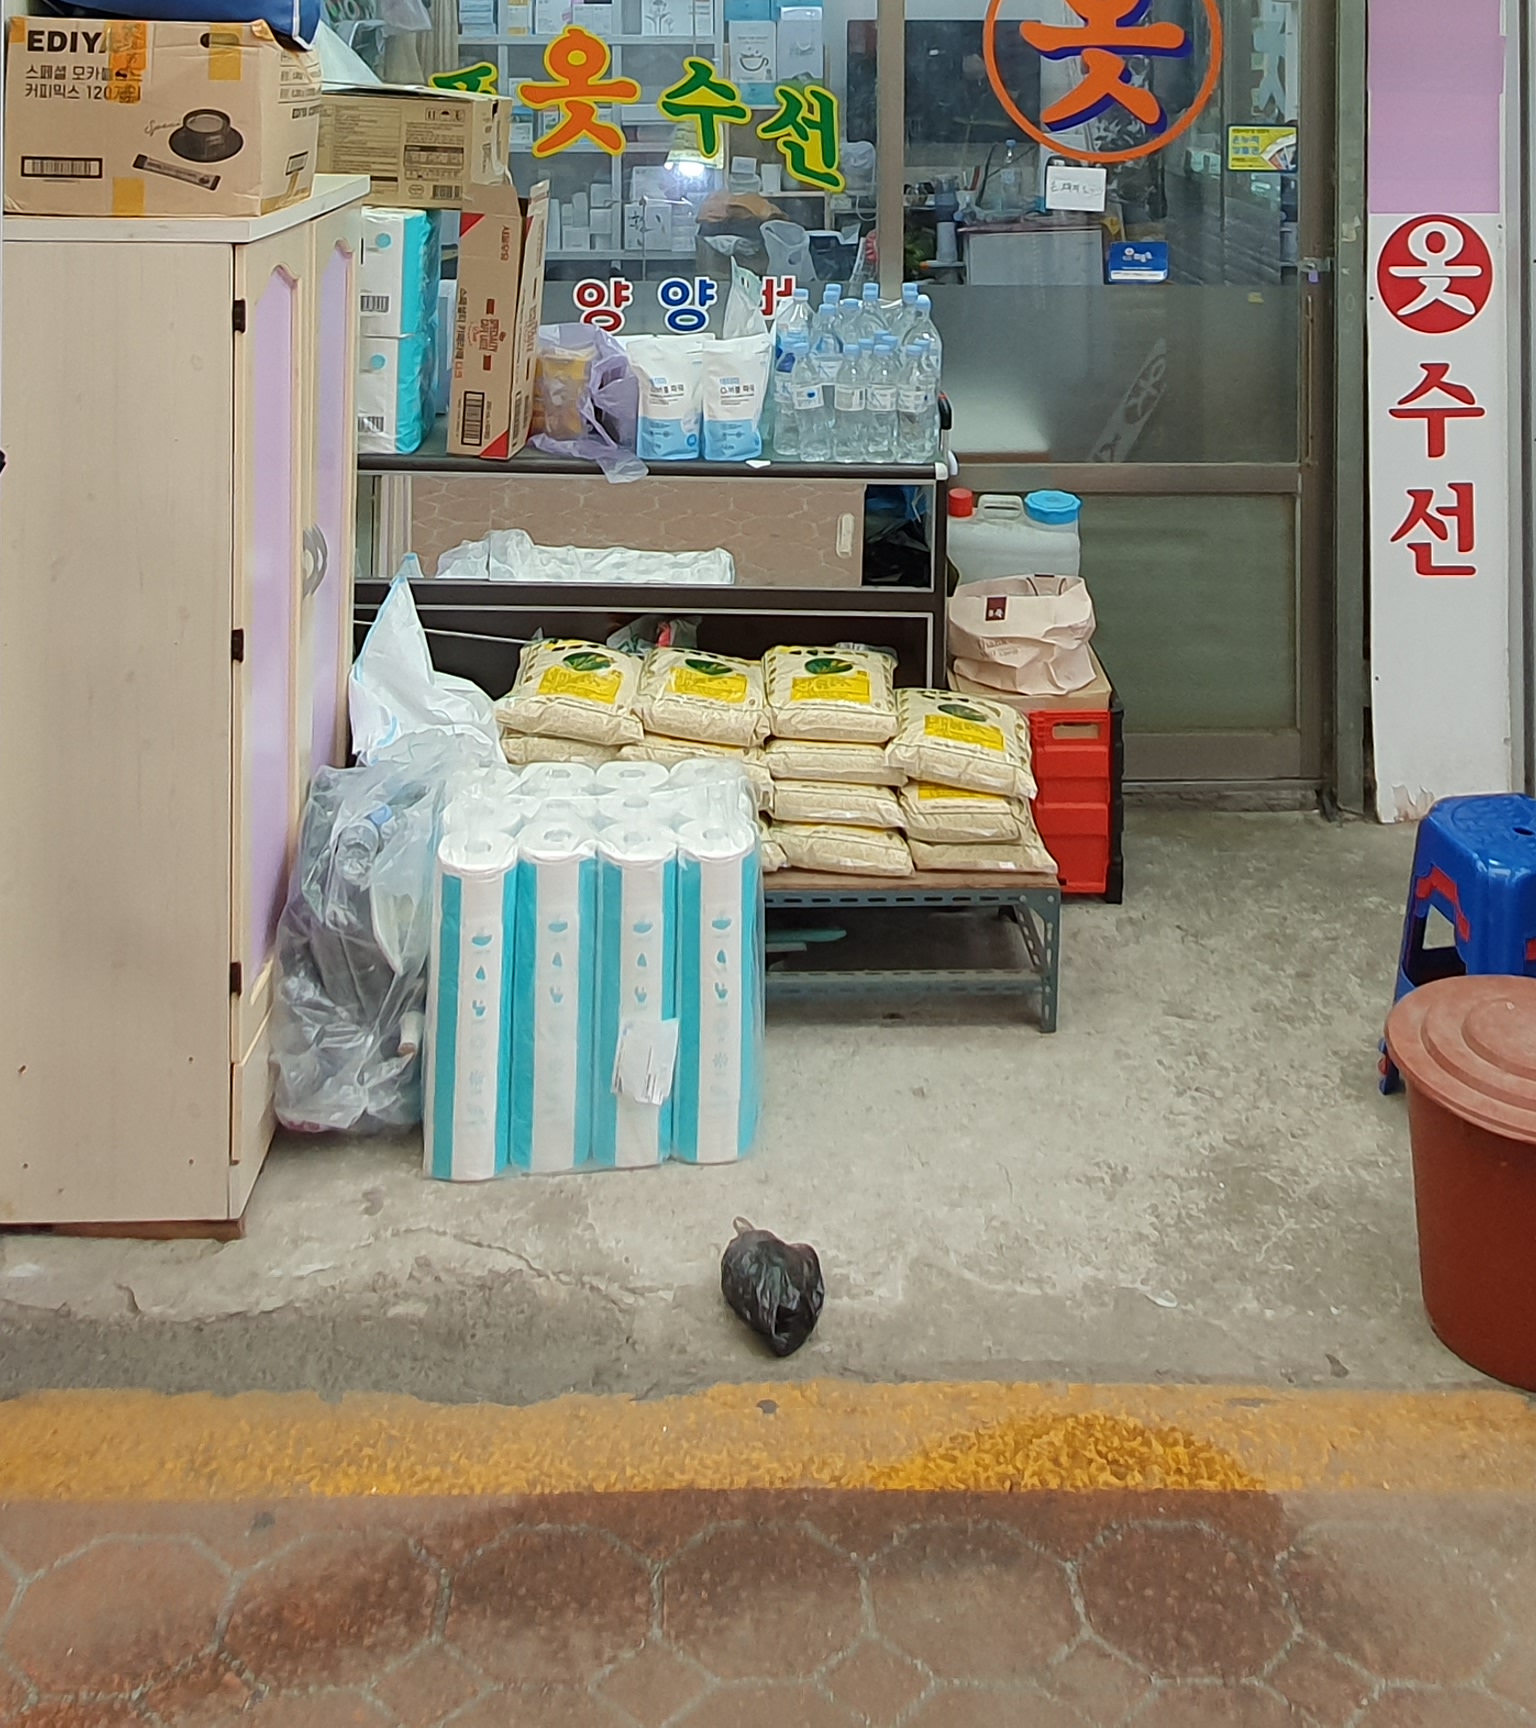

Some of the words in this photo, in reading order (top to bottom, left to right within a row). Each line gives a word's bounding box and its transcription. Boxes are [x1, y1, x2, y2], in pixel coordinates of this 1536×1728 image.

[25, 64, 67, 81] 스페셜
[25, 83, 81, 100] 커피믹스
[1387, 221, 1484, 318] 옷
